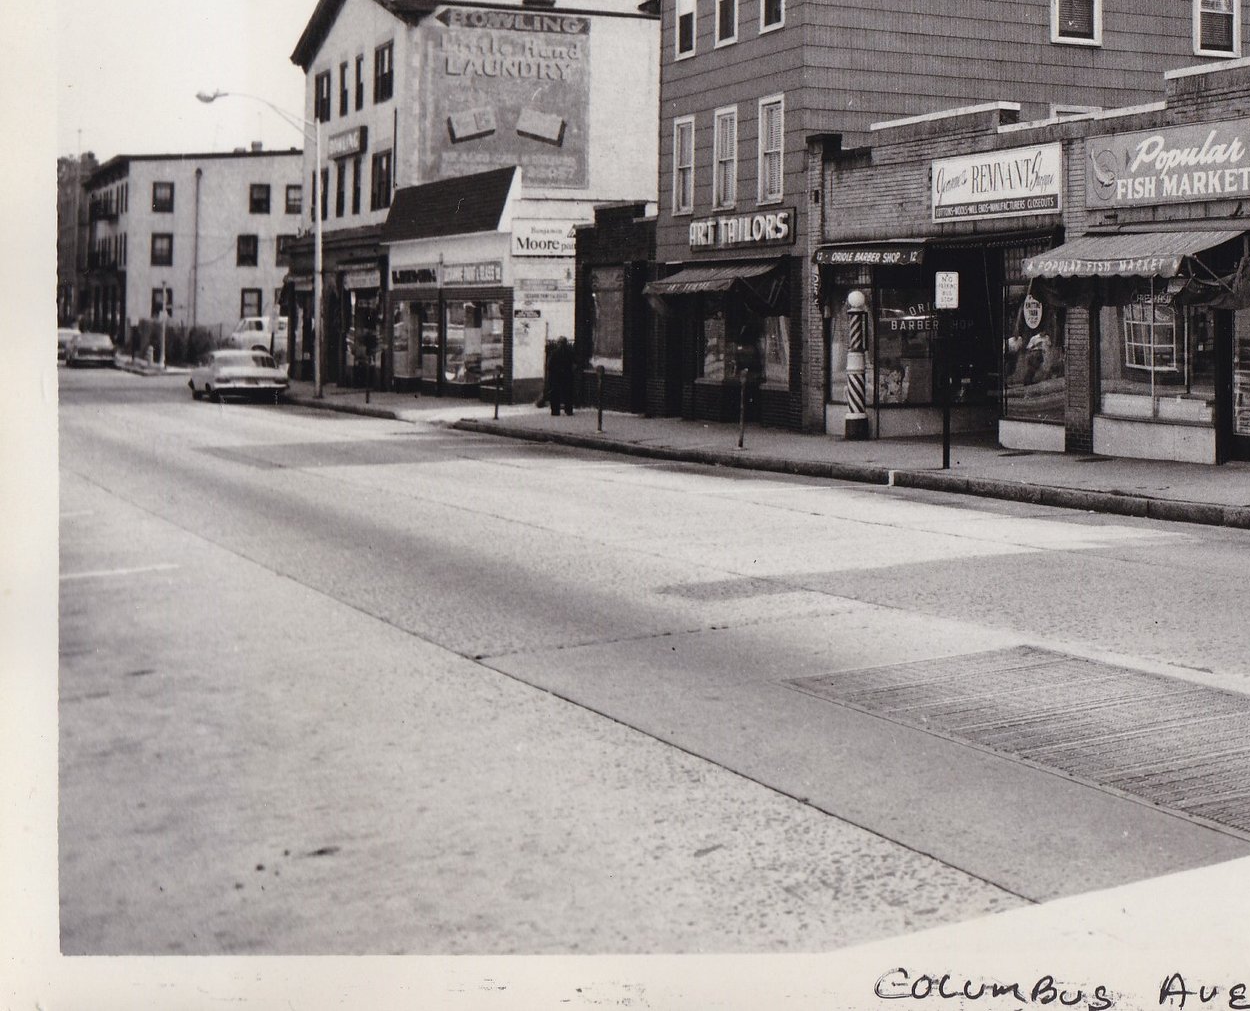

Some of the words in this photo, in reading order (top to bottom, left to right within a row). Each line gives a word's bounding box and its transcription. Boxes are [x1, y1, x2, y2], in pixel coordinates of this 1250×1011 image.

[451, 9, 584, 34] BOWLING
[444, 55, 571, 81] LAUNDRY
[1130, 129, 1246, 180] Popular
[971, 158, 1032, 194] REMNANT
[1116, 175, 1157, 200] FISH
[689, 220, 717, 247] ART
[720, 212, 789, 246] TAILORS
[516, 236, 560, 251] Moore
[831, 252, 853, 262] ORIOLE
[854, 252, 880, 263] BARBER
[882, 251, 901, 264] SHOP
[909, 251, 918, 262] 12
[1038, 259, 1082, 274] POPULAR
[1085, 260, 1111, 273] FISH
[1118, 258, 1164, 272] MARKET
[891, 319, 940, 332] BARBER
